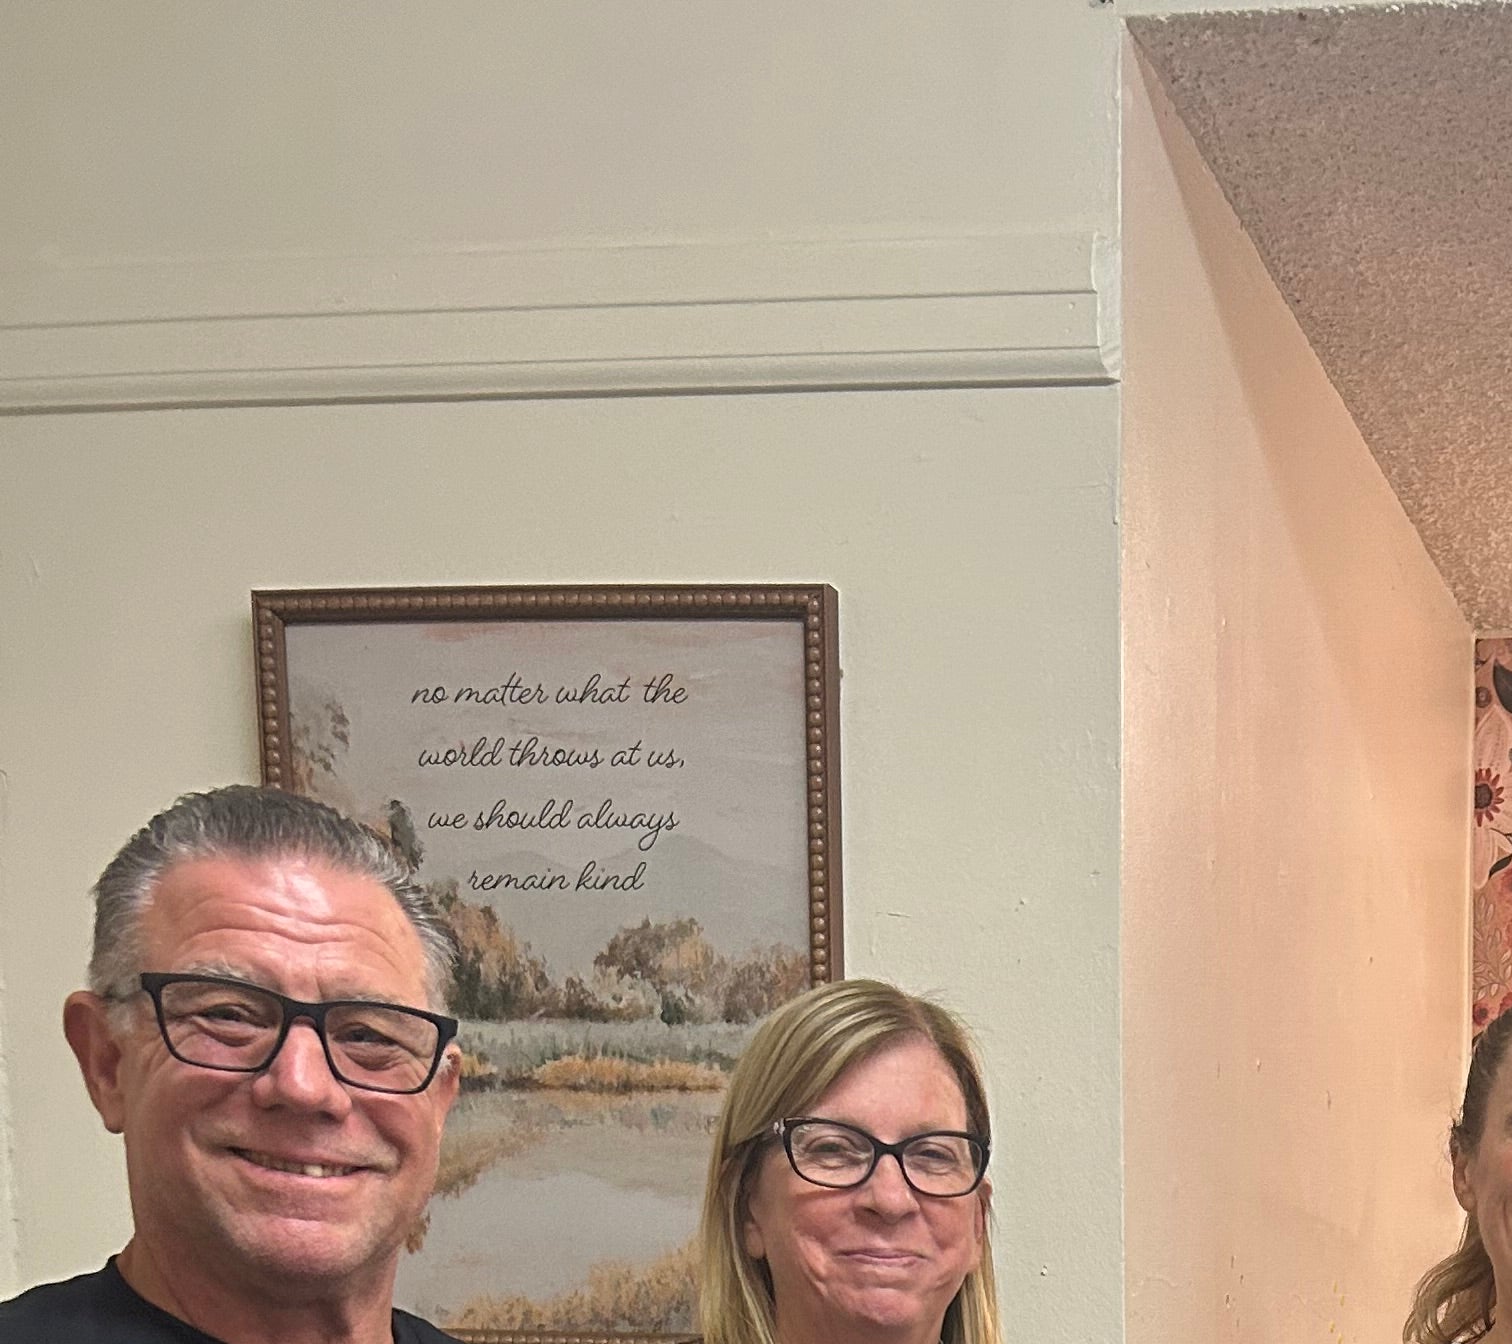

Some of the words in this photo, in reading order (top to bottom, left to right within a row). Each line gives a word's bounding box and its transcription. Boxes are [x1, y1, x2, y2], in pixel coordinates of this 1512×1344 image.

[411, 686, 449, 705] no
[453, 672, 550, 706] matter
[555, 673, 632, 705] what
[643, 673, 689, 705] the
[417, 737, 505, 768] world
[509, 738, 605, 768] throws
[610, 740, 642, 768] at
[647, 749, 685, 769] us,
[428, 812, 468, 830] we
[473, 799, 574, 831] should
[577, 799, 680, 851] always
[468, 868, 570, 892] remain
[575, 860, 648, 892] kind
